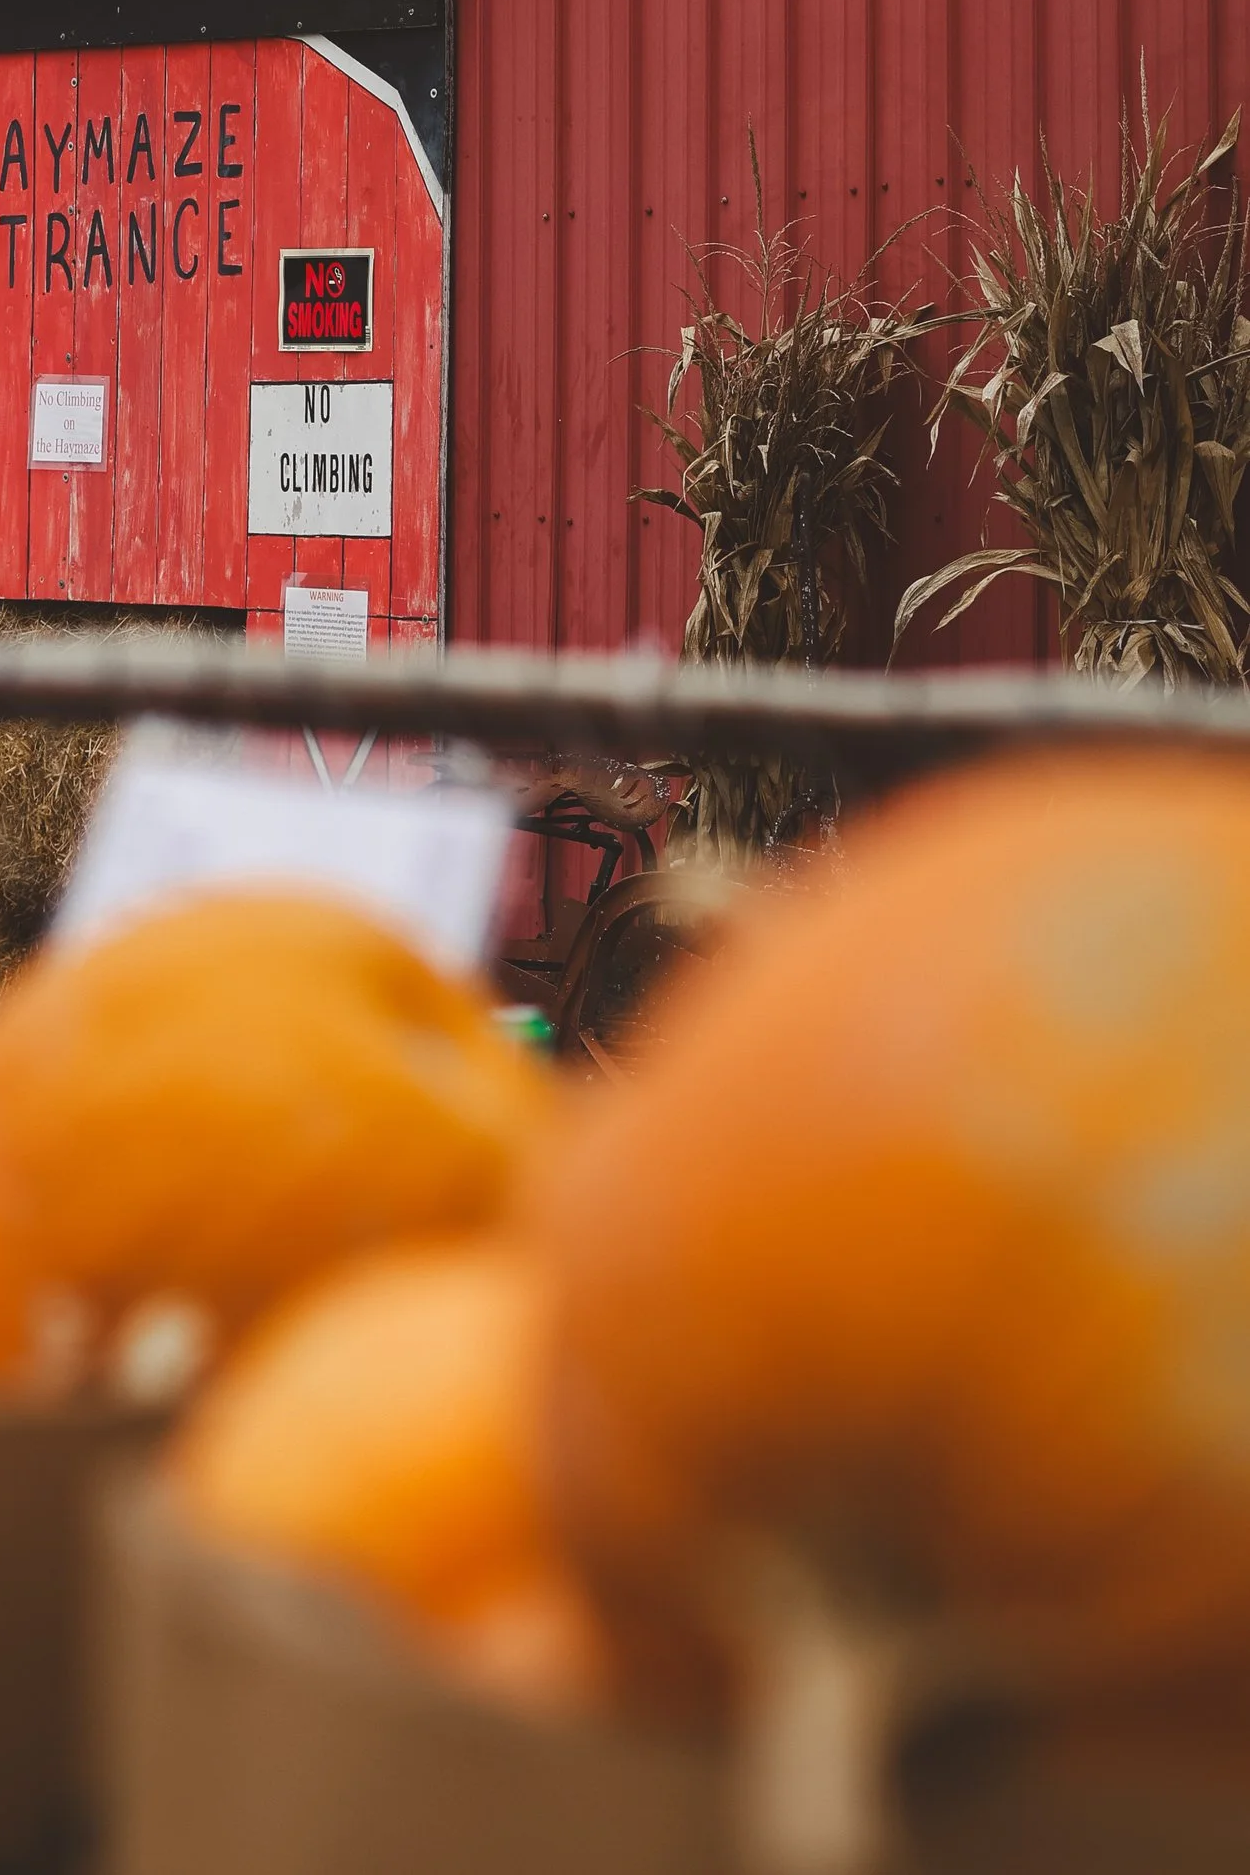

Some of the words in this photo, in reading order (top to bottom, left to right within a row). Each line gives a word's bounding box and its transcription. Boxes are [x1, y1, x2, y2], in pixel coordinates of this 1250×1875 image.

[305, 262, 345, 298] NO
[288, 301, 363, 338] SMOKING
[38, 390, 54, 406] No
[56, 390, 102, 411] Climbing
[304, 385, 330, 423] NO
[63, 419, 75, 430] on
[36, 437, 52, 453] the
[54, 438, 100, 457] Haymaze
[280, 452, 373, 493] CLIMBING
[309, 590, 344, 602] WARNING
